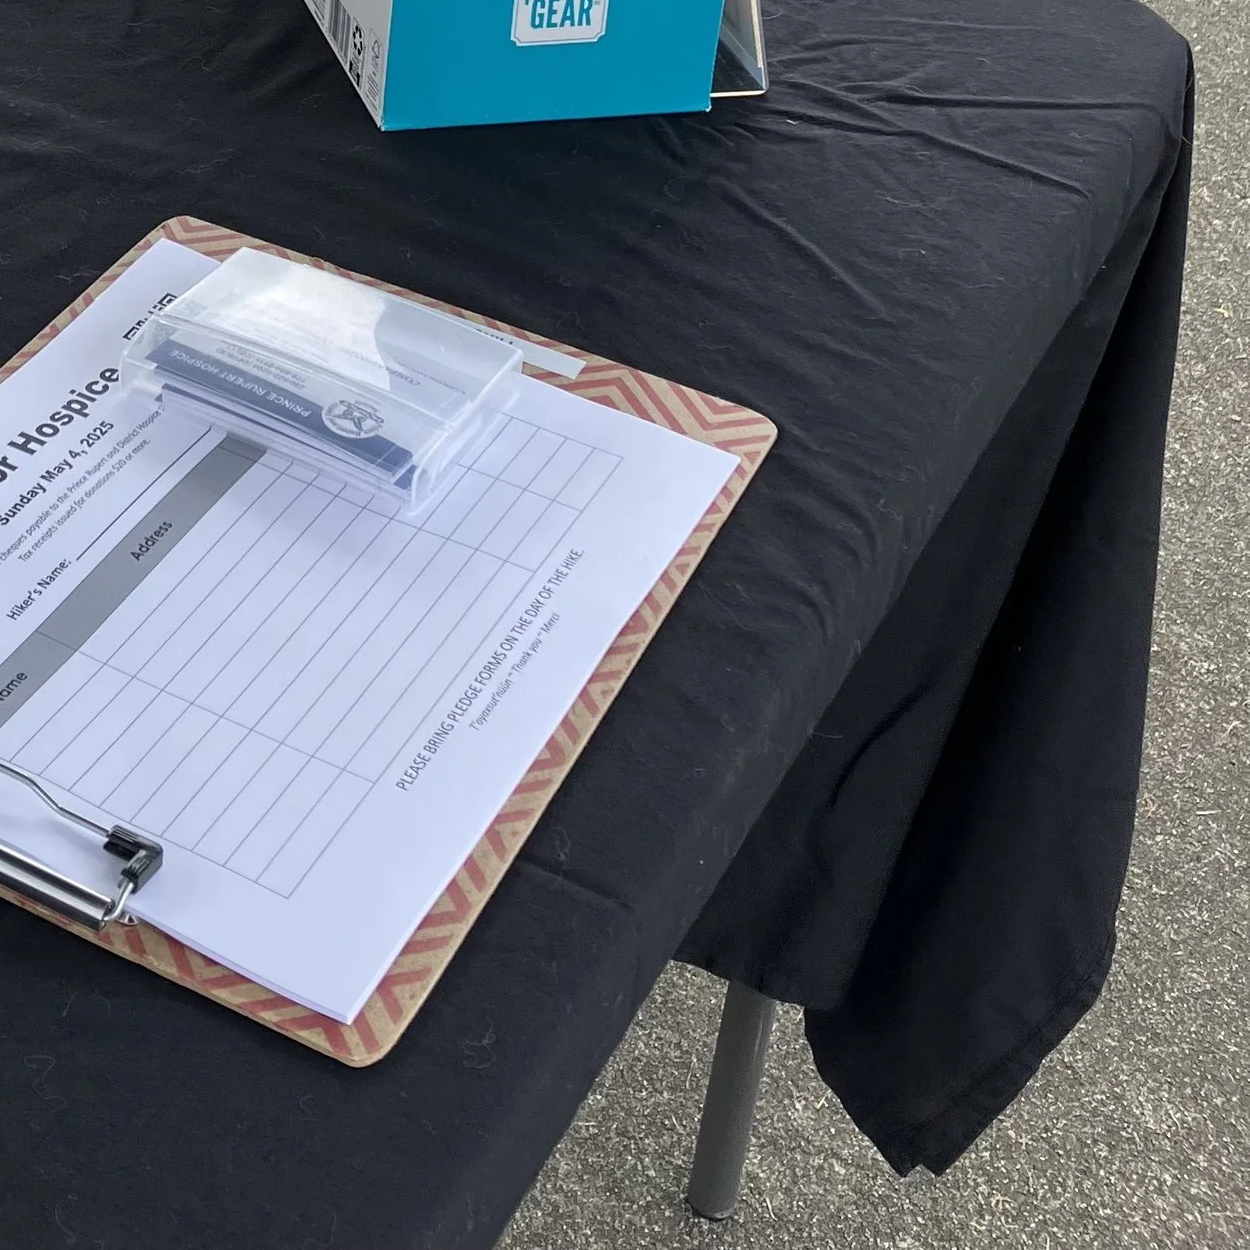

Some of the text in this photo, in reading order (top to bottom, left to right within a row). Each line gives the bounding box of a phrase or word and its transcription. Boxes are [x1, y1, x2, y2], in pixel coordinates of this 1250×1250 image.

[169, 349, 220, 374] HOSPICE
[218, 370, 268, 396] RUPERT
[6, 367, 120, 456] Hospice
[265, 391, 313, 418] PRINCE
[38, 458, 74, 483] May
[68, 449, 89, 460] 4,
[79, 420, 115, 449] 2025
[0, 533, 28, 562] cheques
[24, 509, 53, 537] payable
[66, 474, 90, 496] Prince
[84, 457, 109, 479] Rupert
[106, 446, 121, 460] and
[115, 428, 141, 449] District
[135, 409, 163, 431] Hospice
[17, 549, 35, 563] Tax
[30, 524, 59, 552] receipts
[53, 504, 78, 527] issued
[73, 496, 87, 511] for
[84, 469, 116, 499] donations
[131, 439, 151, 455] more.
[130, 521, 173, 562] Address
[5, 558, 72, 621] Hiker's Name:
[394, 548, 586, 792] PLEASE BRING PLEDGE FORMS ON THE DAY OF THE HIKE.
[510, 650, 534, 674] Thank
[527, 637, 543, 654] you
[539, 612, 560, 635] Merci
